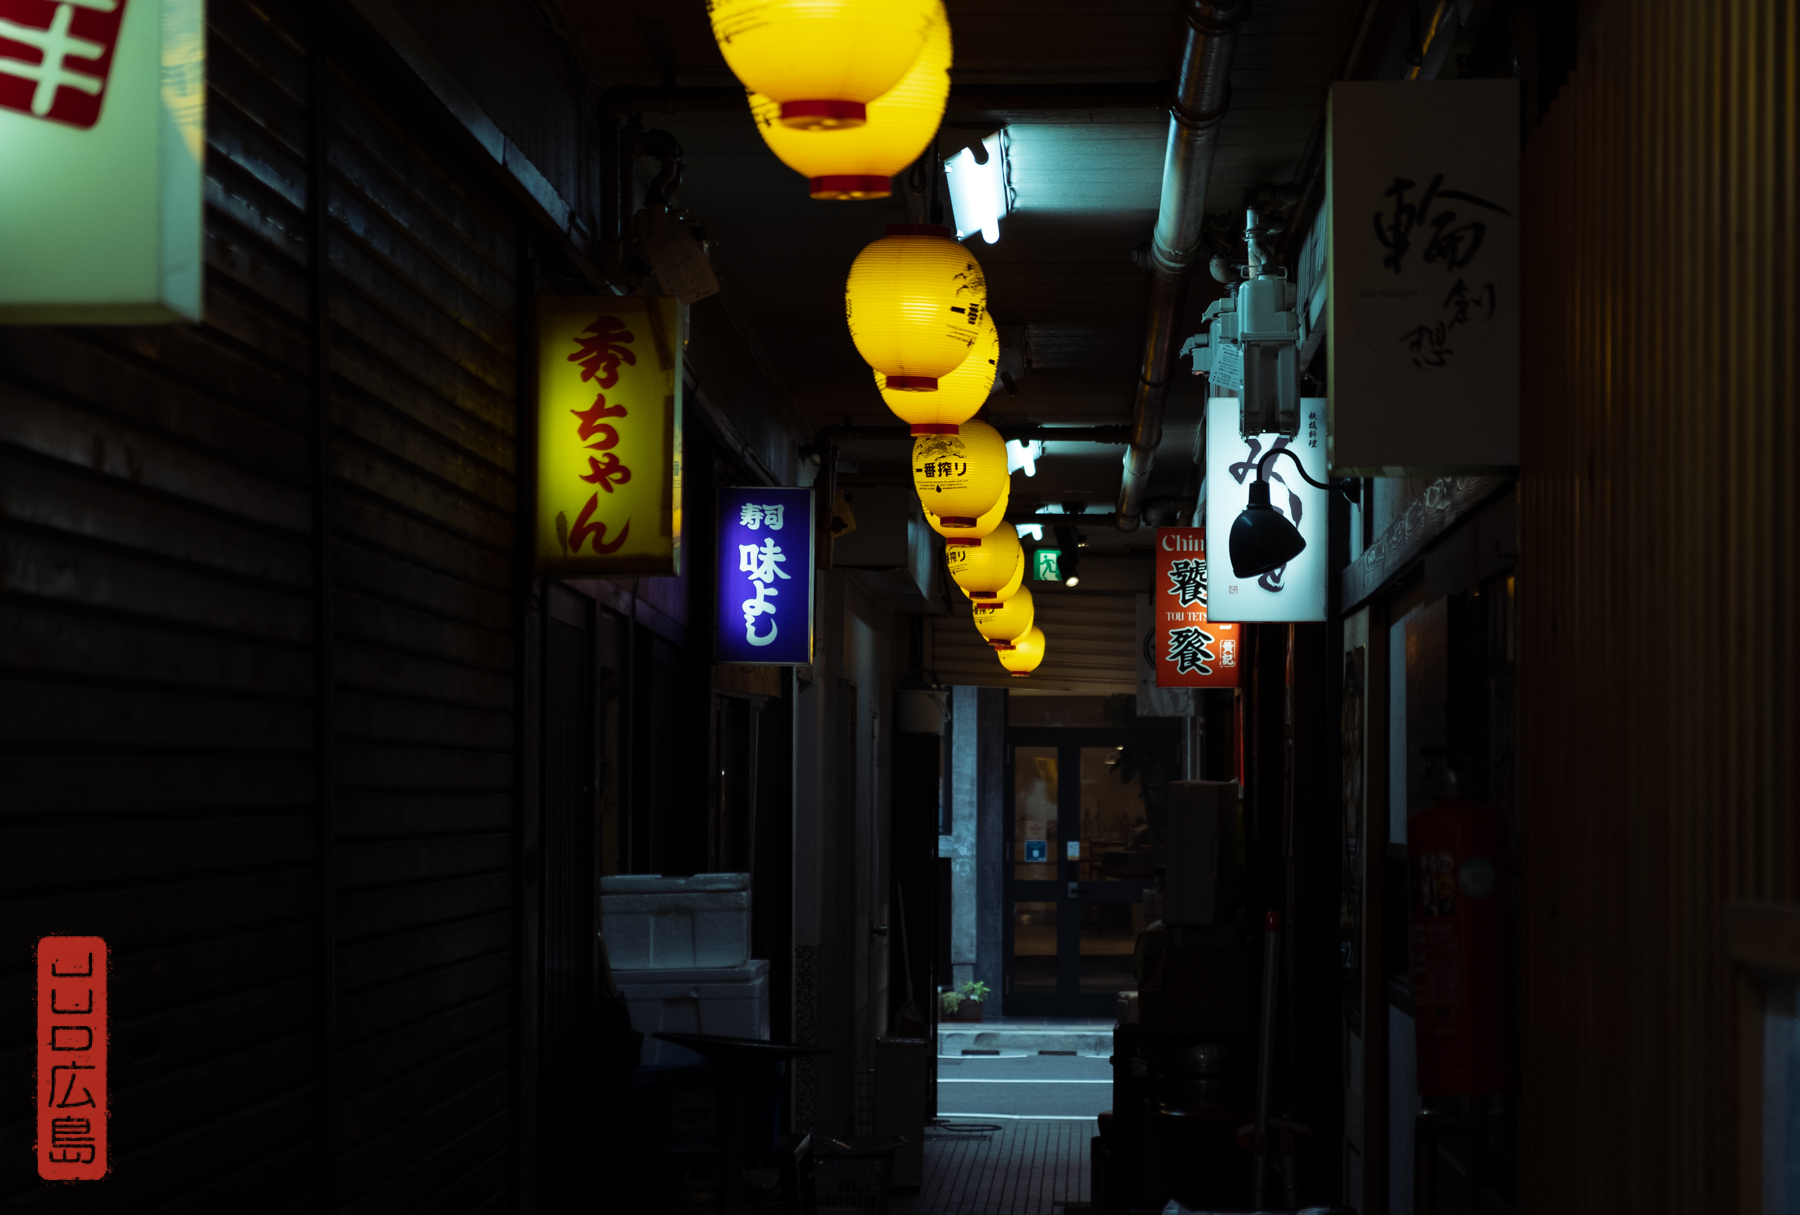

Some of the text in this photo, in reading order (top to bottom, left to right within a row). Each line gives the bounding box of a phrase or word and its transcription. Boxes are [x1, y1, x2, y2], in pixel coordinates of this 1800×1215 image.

[567, 316, 637, 555] 秀ちゃん
[916, 462, 966, 478] 一番搾り
[739, 503, 784, 530] 寿司
[738, 537, 792, 647] 味よし
[1166, 612, 1184, 621] TOU
